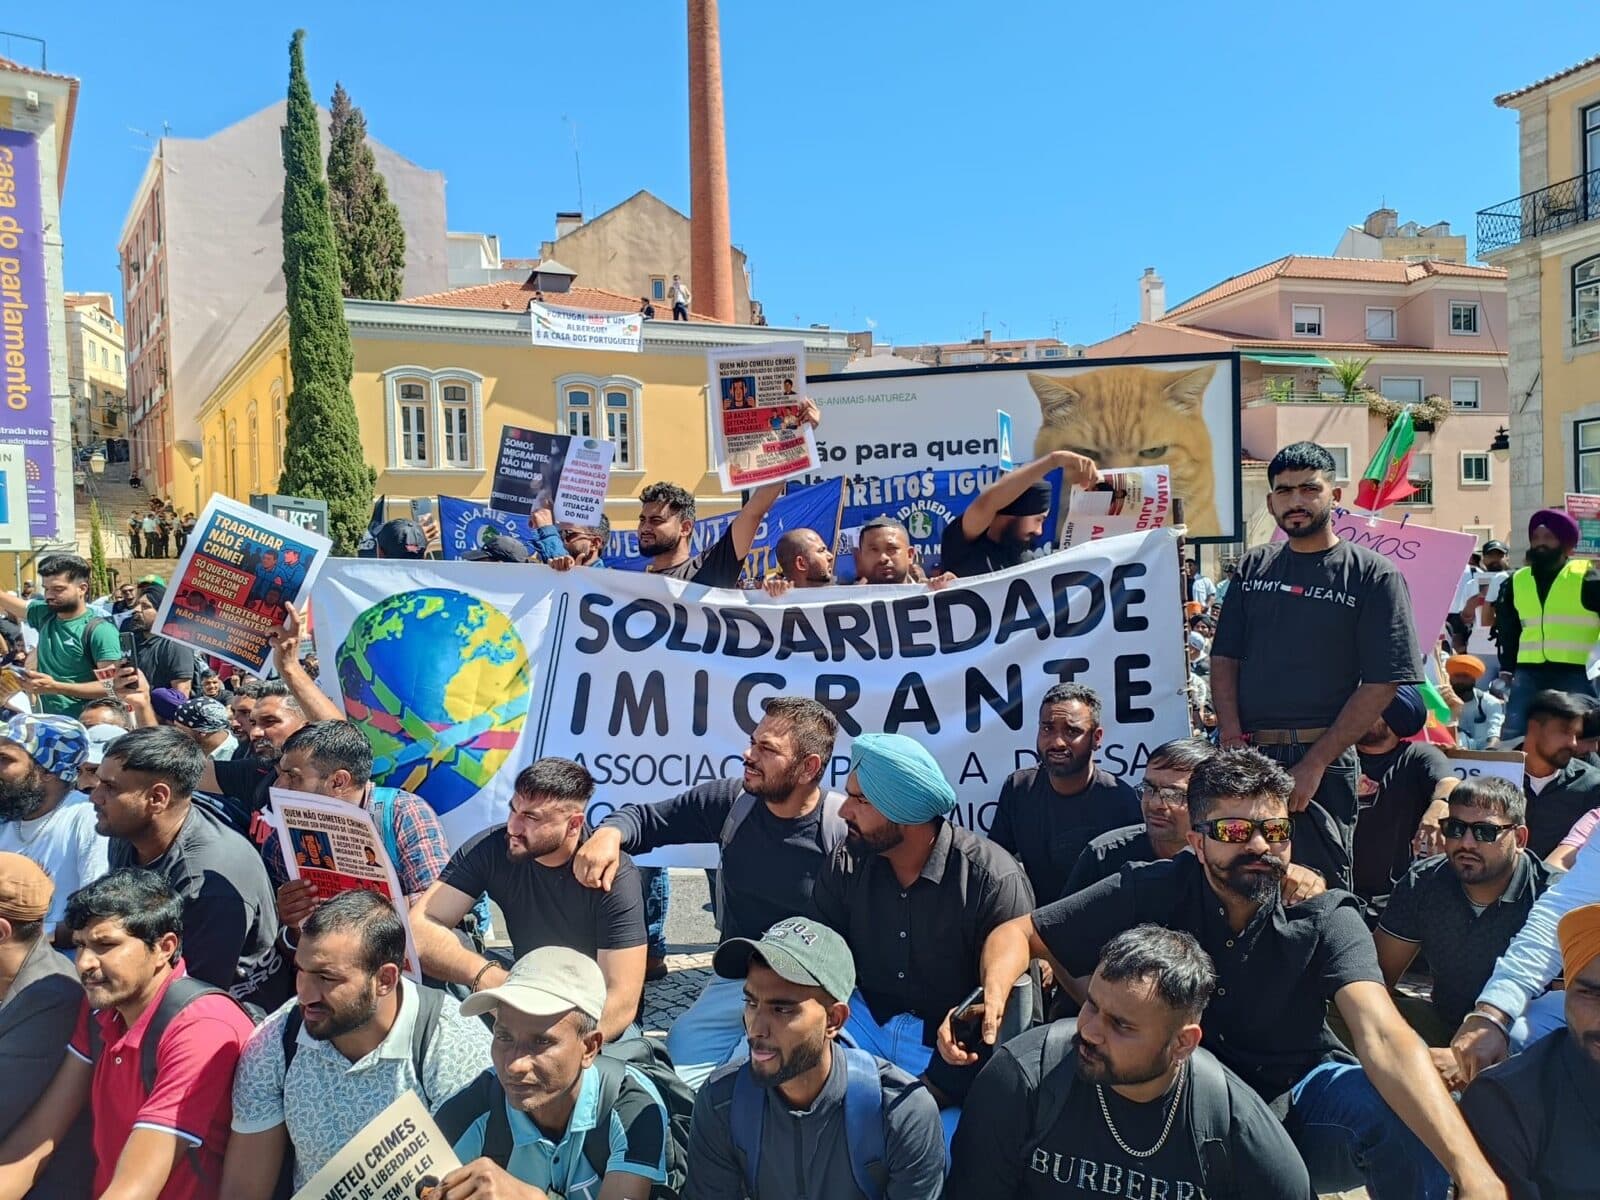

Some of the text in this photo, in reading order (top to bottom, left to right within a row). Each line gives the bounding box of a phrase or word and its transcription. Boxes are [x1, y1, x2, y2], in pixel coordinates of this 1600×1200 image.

[0, 145, 32, 411] casa do parlamento
[551, 332, 571, 341] CASA
[0, 427, 48, 436] trada livre
[505, 438, 534, 450] SOMOS
[856, 441, 917, 466] para
[500, 467, 543, 481] CRIMINOSO
[502, 456, 533, 470] NÃO UM
[564, 467, 607, 480] INFORMAÇÃO
[571, 460, 603, 470] RESOLVER
[571, 477, 594, 486] ALERTA
[844, 472, 936, 508] IREITOS
[561, 493, 594, 504] RESOLVER
[1156, 474, 1169, 514] AIMA
[563, 502, 595, 513] SITUAÇÃO
[564, 510, 576, 518] DO
[896, 500, 957, 526] IDARIEDA
[1136, 496, 1155, 532] AJUD
[289, 510, 318, 530] KFC
[208, 528, 244, 550] NÃO É
[214, 514, 284, 551] TRABALHAR
[203, 542, 245, 565] CRIME!
[194, 558, 250, 586] SÓ QUEREMOS
[198, 570, 241, 591] VIVER COM
[190, 578, 237, 600] DIGNIDADE!
[1304, 584, 1356, 608] JEANS
[176, 606, 194, 620] NÃO
[195, 614, 226, 632] SOMOS
[217, 601, 273, 627] LIBERTEM OS
[575, 562, 1149, 663] SOLIDARIEDADE
[228, 634, 261, 654] SOMOS
[570, 653, 1155, 738] IMIGRANTE
[959, 751, 989, 785] A
[284, 808, 369, 832] QUEM NÃO COMETEU CRIMES
[286, 818, 297, 826] NÃO
[298, 820, 310, 828] PODE
[320, 822, 340, 832] PRIVADO
[350, 836, 359, 844] TEM
[365, 1118, 416, 1169] CRIMES
[358, 1130, 430, 1200] DE LIBERDADE!
[382, 1154, 434, 1200] TEM DE LEI
